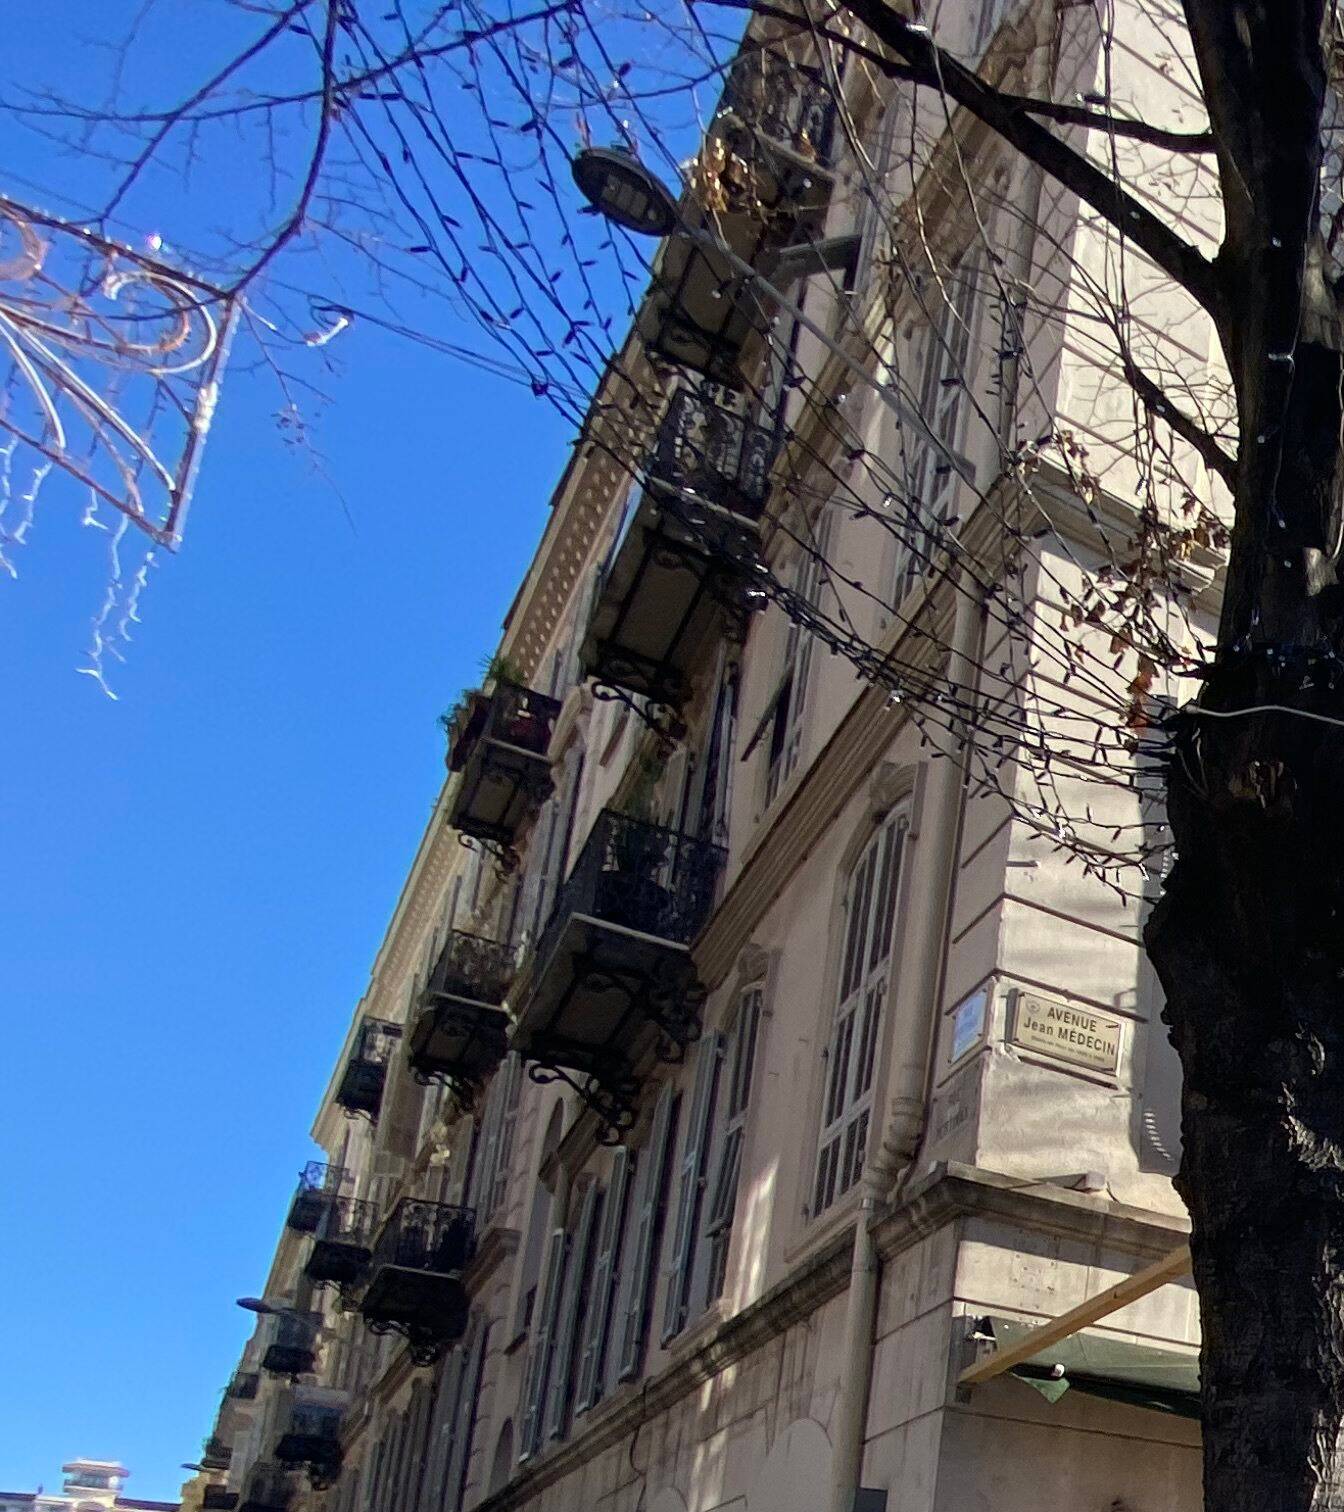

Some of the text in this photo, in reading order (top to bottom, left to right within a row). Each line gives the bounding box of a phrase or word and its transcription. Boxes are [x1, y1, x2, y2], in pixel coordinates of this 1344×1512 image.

[1047, 1006, 1097, 1032] AVENUE
[1023, 1017, 1054, 1036] Jean
[1058, 1026, 1115, 1056] MÉDECIN
